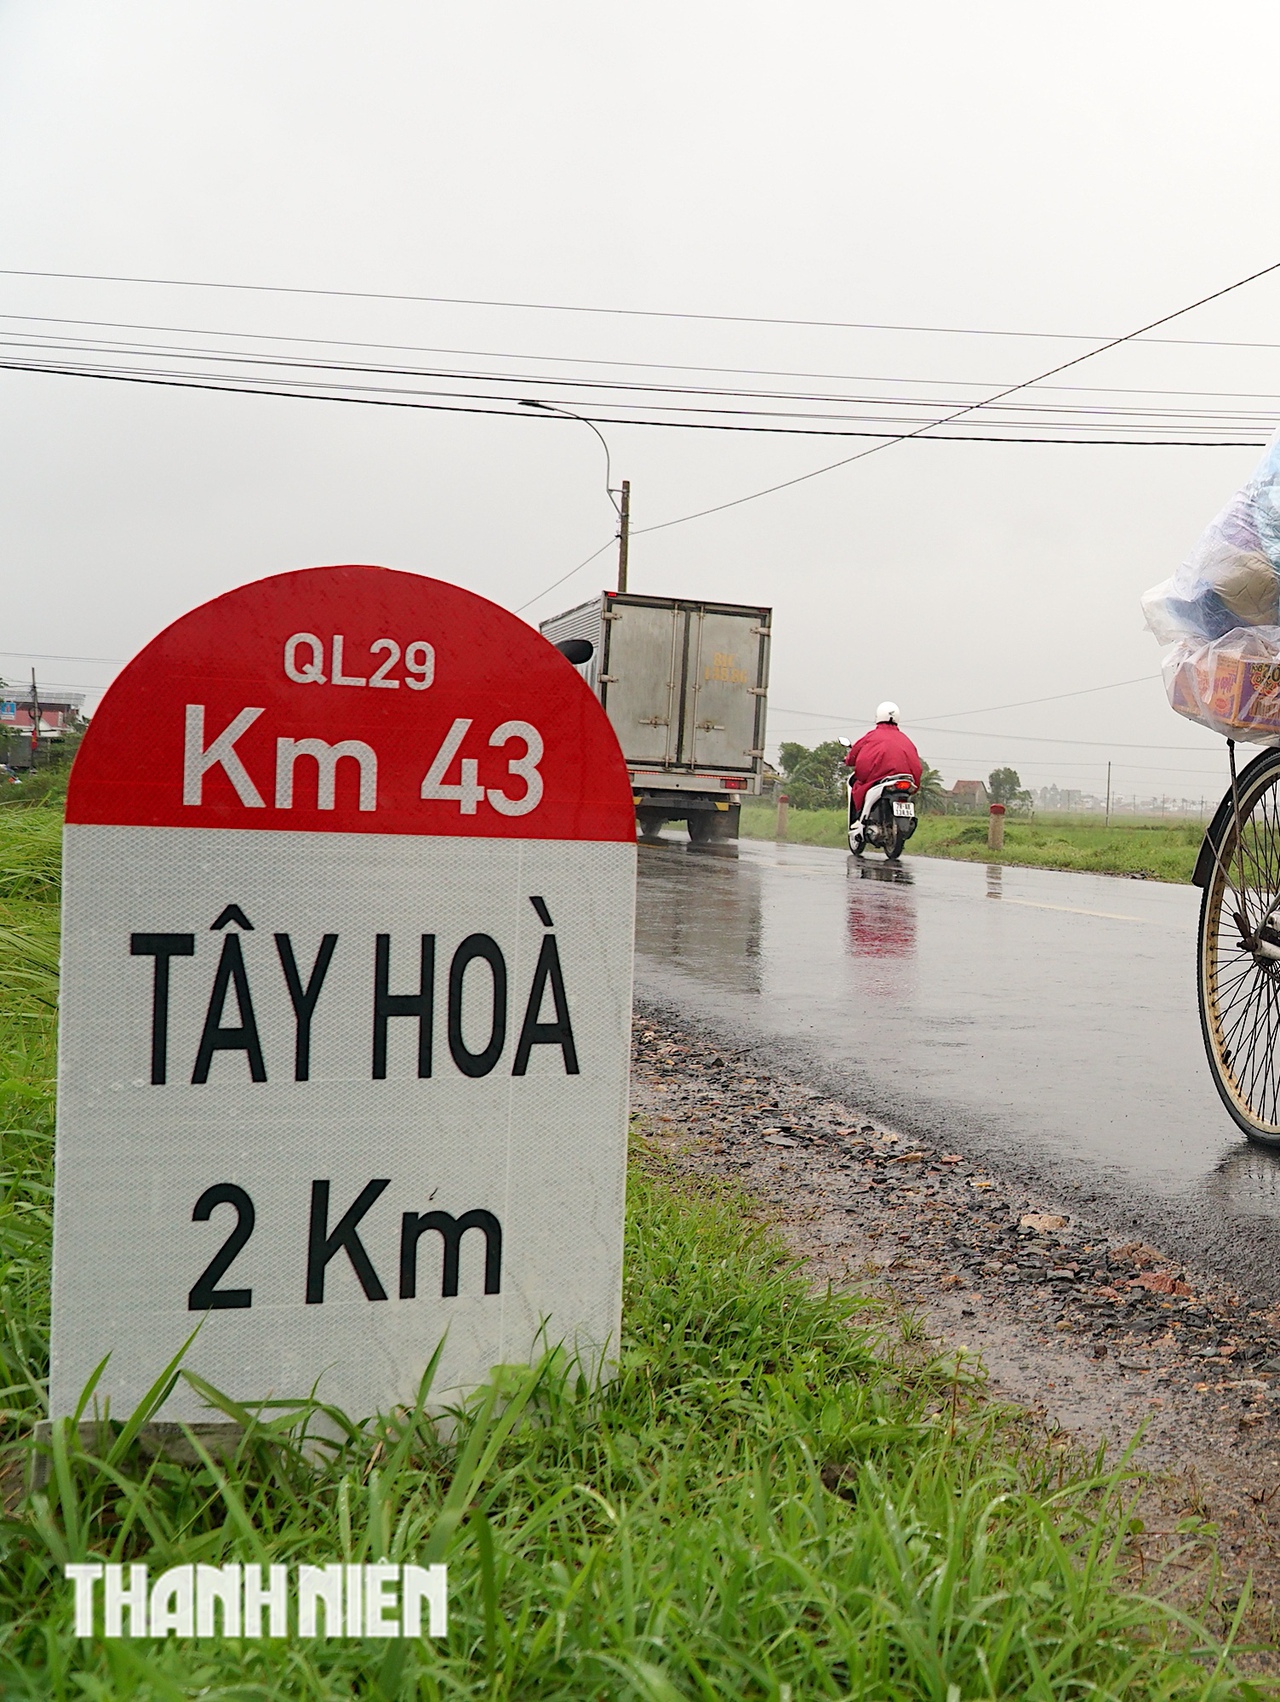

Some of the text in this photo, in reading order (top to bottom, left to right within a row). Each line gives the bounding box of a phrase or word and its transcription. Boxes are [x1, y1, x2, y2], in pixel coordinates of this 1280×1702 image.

[284, 632, 435, 691] QL29
[183, 703, 544, 817] Km 43
[129, 895, 581, 1086] TÂY HOÀ
[187, 1178, 503, 1312] 2 Km
